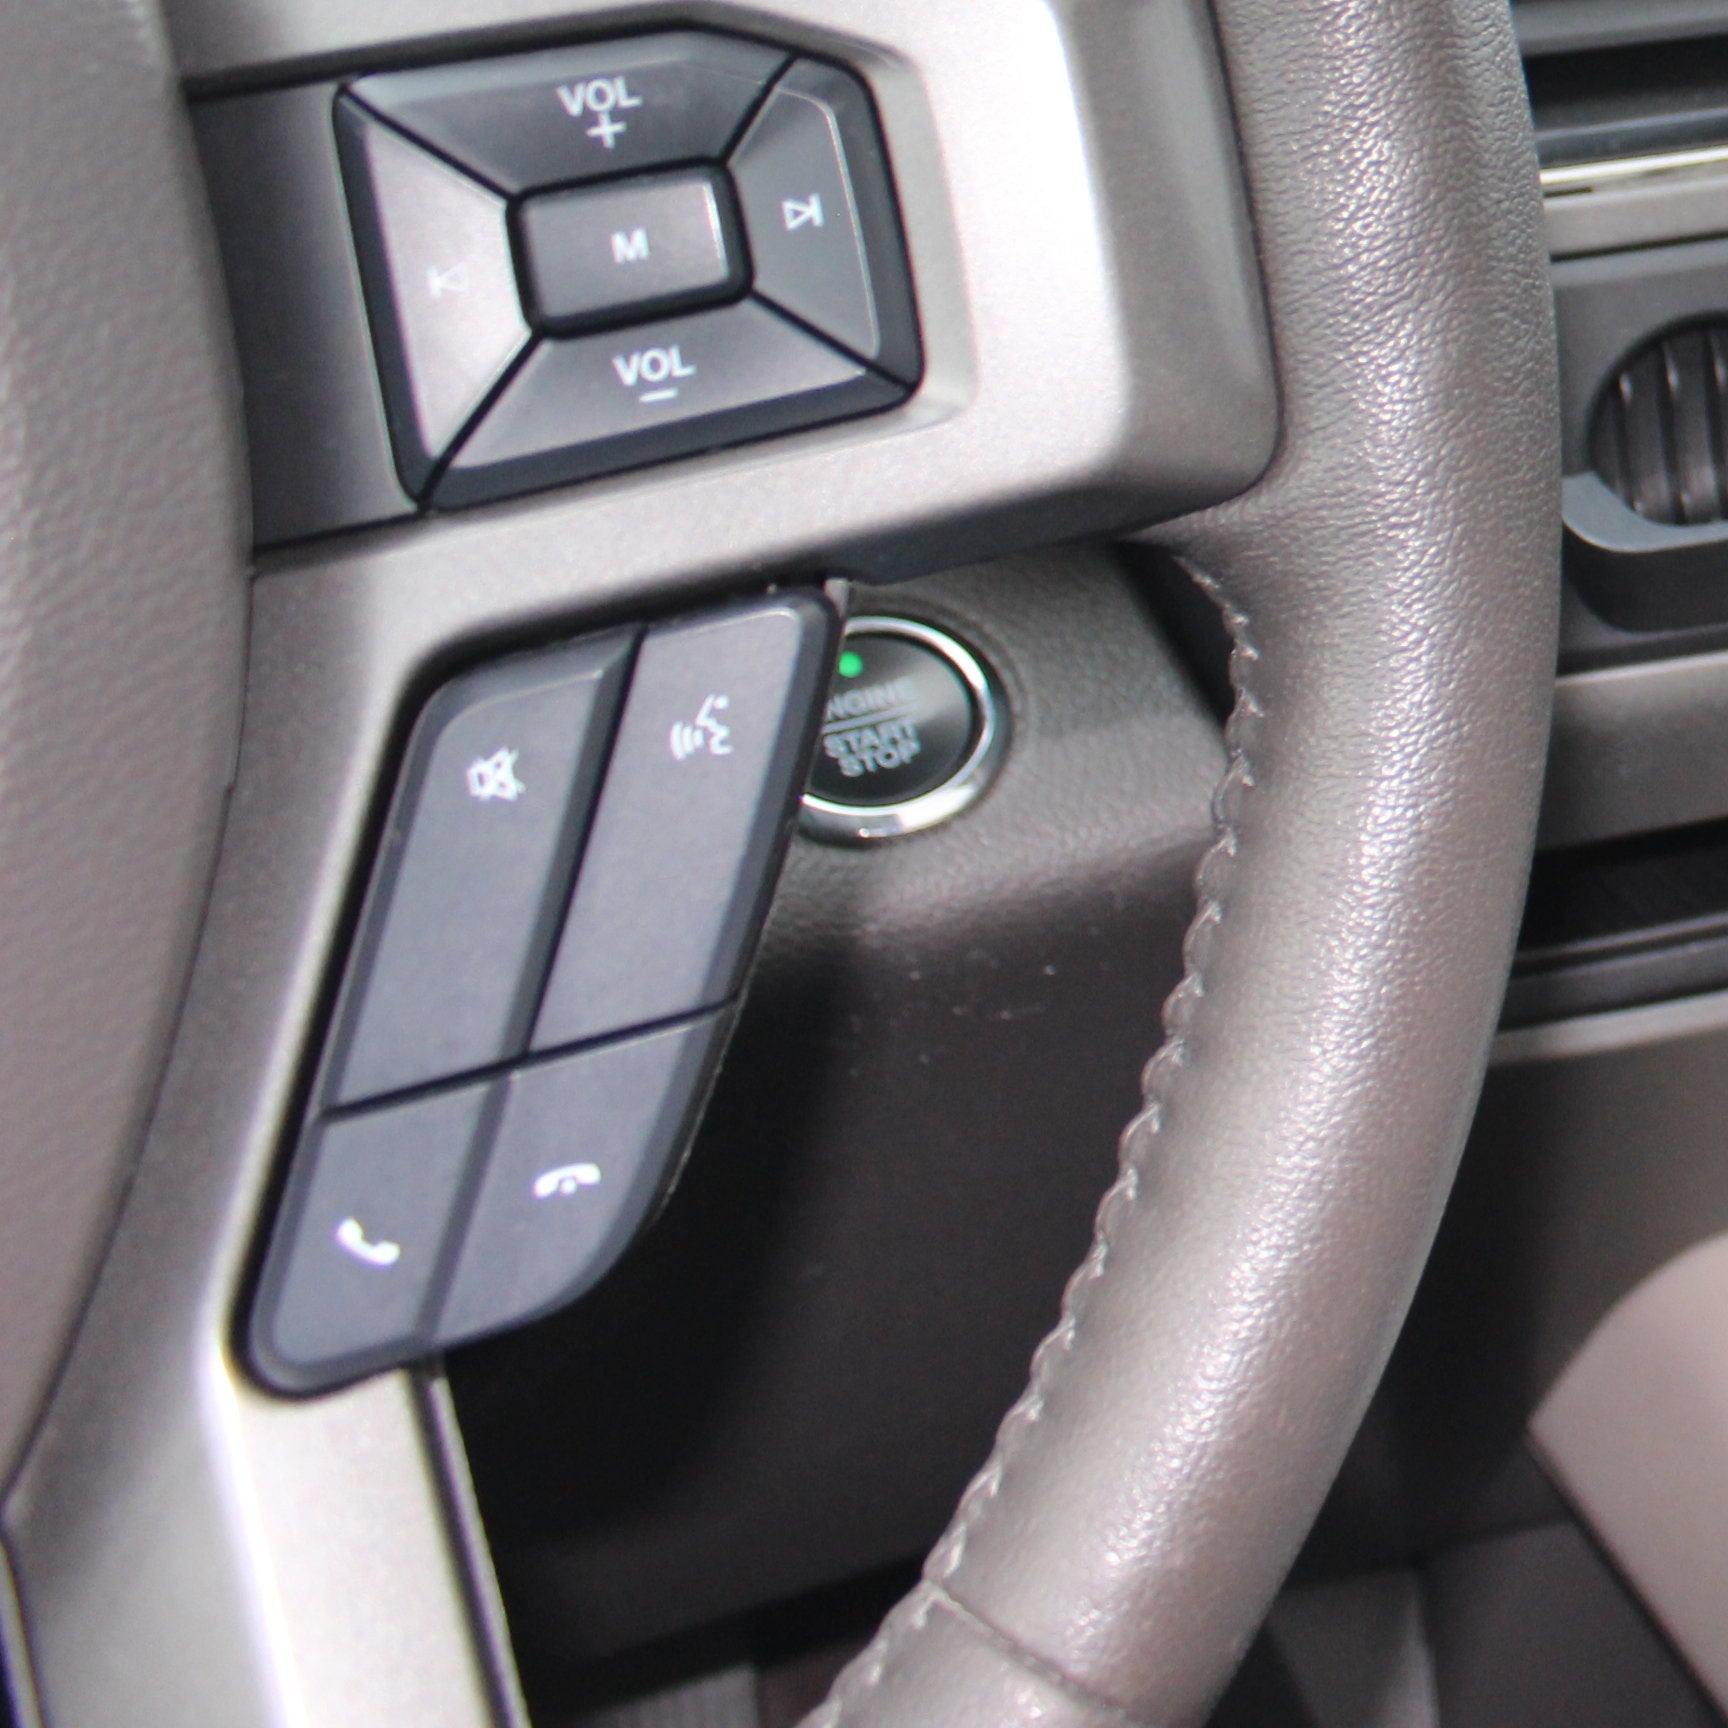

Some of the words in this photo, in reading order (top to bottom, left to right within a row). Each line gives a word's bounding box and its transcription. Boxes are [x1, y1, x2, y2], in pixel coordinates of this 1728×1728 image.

[557, 76, 642, 116] VOL
[610, 229, 649, 264] M
[612, 345, 695, 386] VOL
[828, 675, 916, 719] NGINE
[840, 739, 921, 776] STOP
